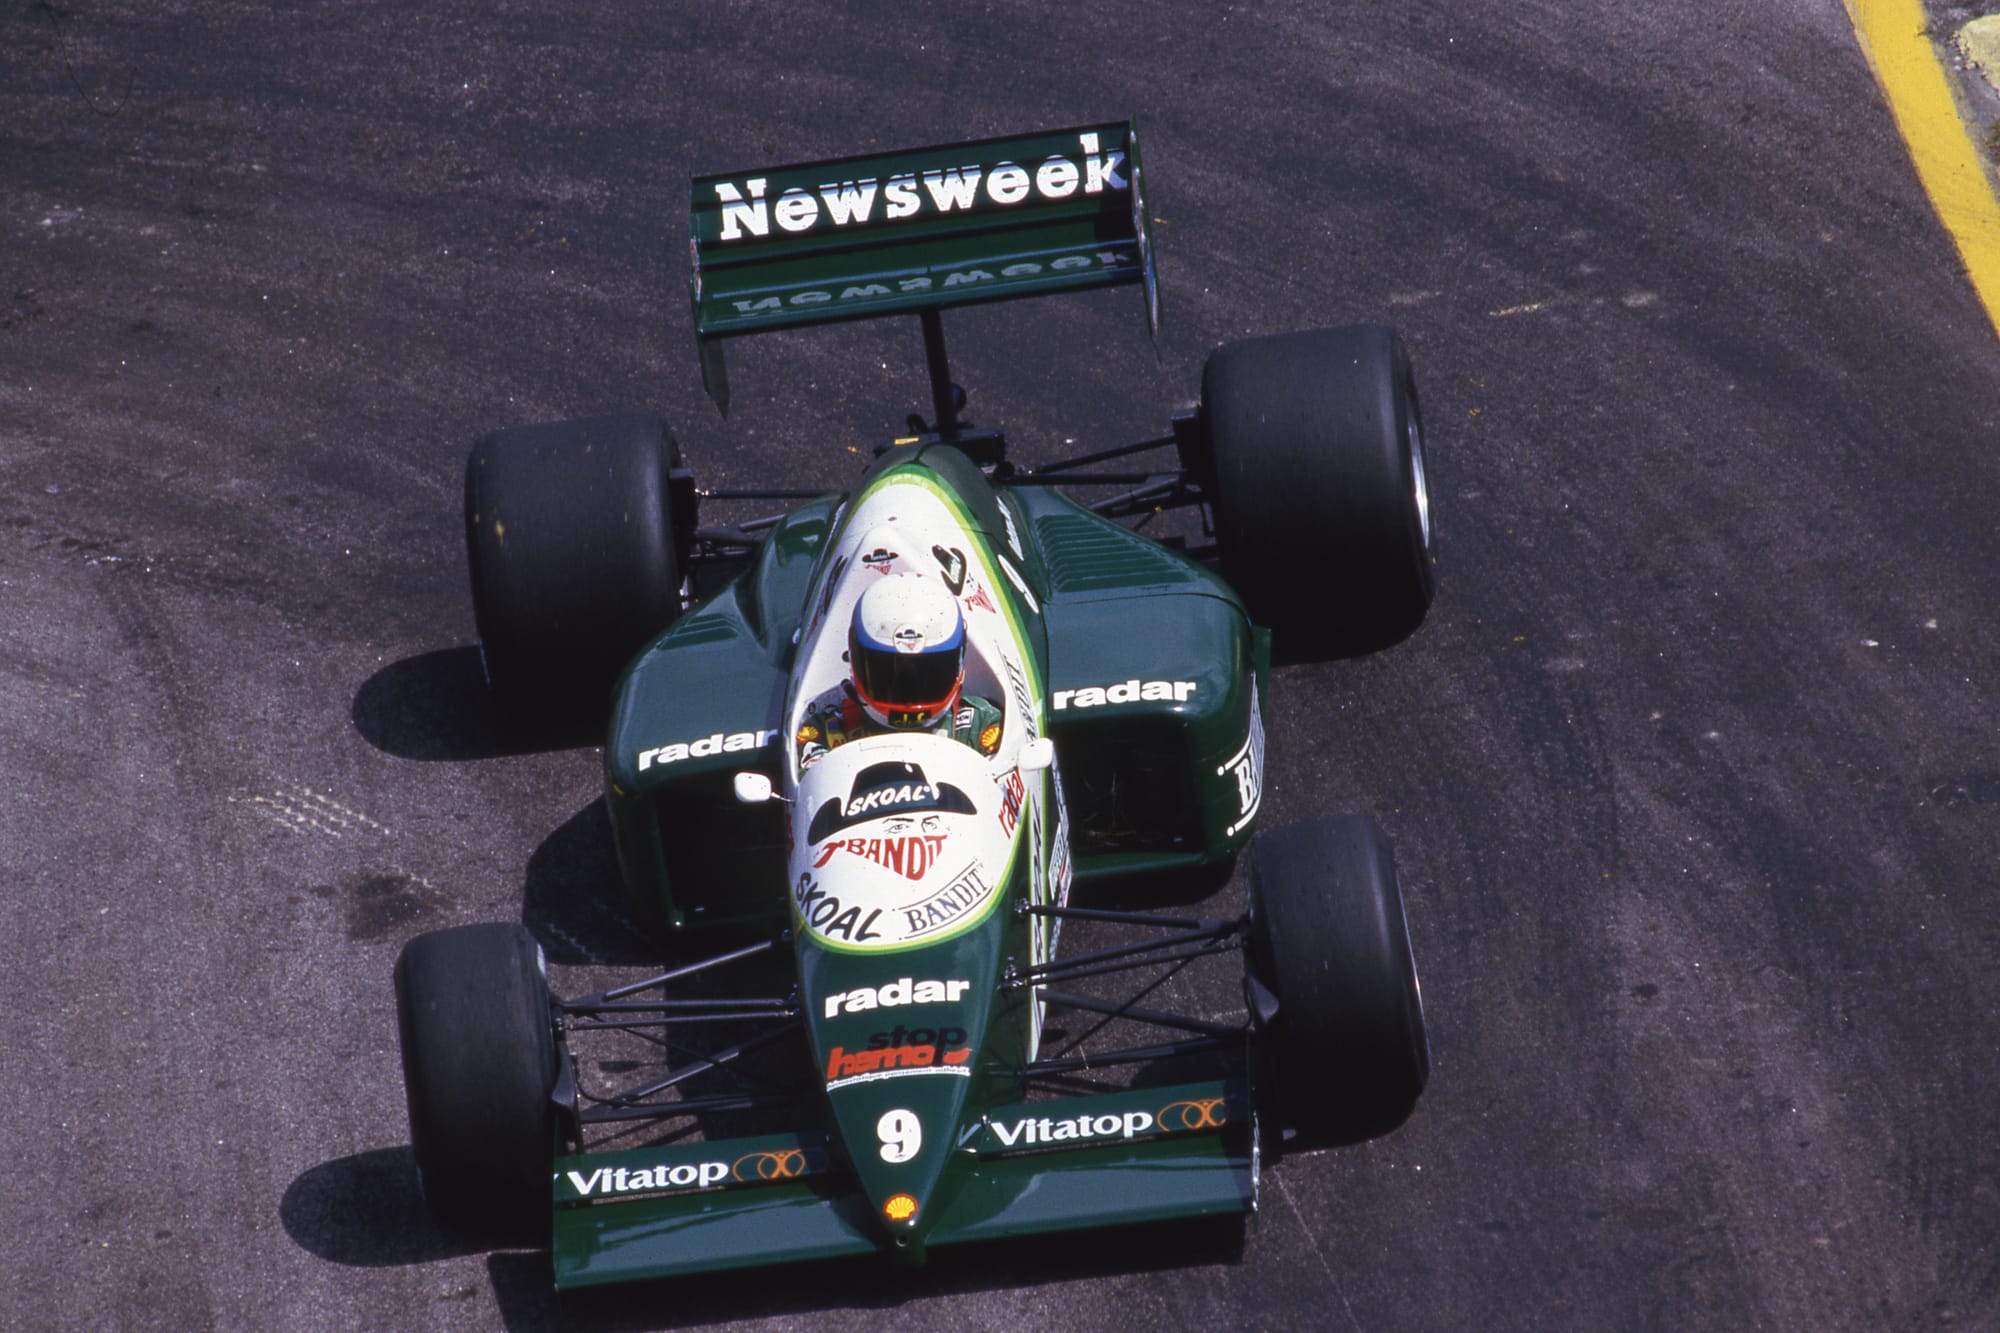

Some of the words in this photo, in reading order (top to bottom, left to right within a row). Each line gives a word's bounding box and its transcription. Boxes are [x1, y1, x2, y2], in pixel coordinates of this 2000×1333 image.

[715, 132, 1128, 241] Newsweek
[1053, 679, 1197, 710] radar
[638, 728, 778, 772] radar
[847, 784, 926, 816] SKOAL
[998, 766, 1025, 839] radar
[796, 871, 883, 942] SKOAL
[903, 868, 988, 933] BANDIT
[824, 977, 971, 1019] radar
[866, 1024, 968, 1066] stop
[876, 1108, 923, 1164] 9
[990, 1110, 1153, 1146] Vitatop
[567, 1161, 730, 1196] Vitatop
